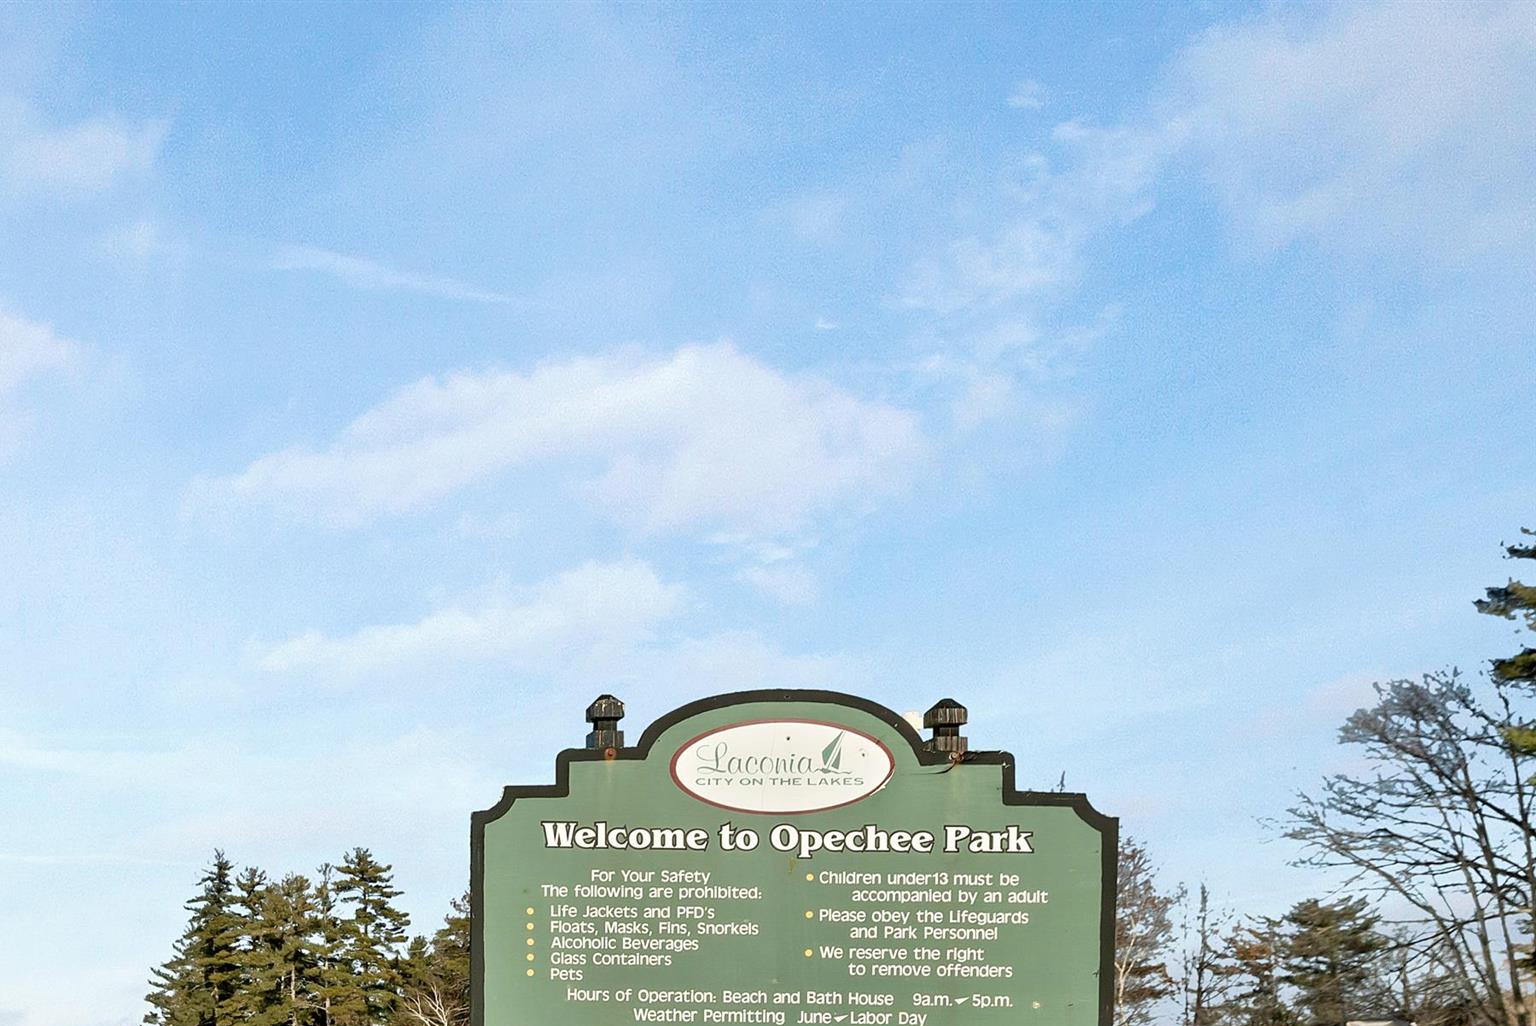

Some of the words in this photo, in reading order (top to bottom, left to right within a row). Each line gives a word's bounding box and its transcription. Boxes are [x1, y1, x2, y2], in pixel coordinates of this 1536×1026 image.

[696, 742, 816, 775] Laconia
[695, 777, 735, 787] CITY
[739, 778, 764, 787] ON
[769, 777, 803, 787] THE
[807, 777, 864, 787] LAKES
[542, 821, 708, 851] Welcome
[719, 822, 761, 850] to
[770, 824, 934, 858] Opechee
[942, 825, 1034, 854] Park
[590, 869, 615, 883] For
[621, 869, 655, 883] Your
[660, 870, 711, 885] Safety
[818, 870, 882, 886] Children
[953, 873, 994, 887] must
[998, 872, 1020, 887] be
[541, 884, 569, 898] The
[573, 884, 644, 900] following
[648, 887, 674, 900] are
[678, 886, 763, 901] prohibited:
[851, 888, 952, 905] accompanied
[957, 889, 978, 905] by
[982, 890, 1002, 904] an
[1007, 889, 1049, 905] adult
[549, 905, 578, 917] Life
[582, 905, 638, 918] Jackets
[642, 906, 671, 919] and
[675, 906, 716, 920] PFD's
[818, 908, 867, 923] Please
[871, 909, 911, 924] obey
[915, 909, 944, 923] the
[948, 909, 1029, 926] Lifeguards
[549, 920, 599, 936] Floats,
[604, 921, 653, 937] Masks,
[658, 921, 692, 937] Fins,
[696, 922, 760, 936] Snorkels
[849, 925, 878, 939] and
[883, 925, 918, 940] Park
[923, 926, 999, 940] Personnel
[550, 936, 617, 950] Alcoholic
[622, 937, 700, 952] Beverages
[550, 952, 587, 965] Glass
[592, 952, 672, 966] Containers
[819, 945, 844, 959] We
[848, 947, 908, 960] reserve
[912, 946, 941, 960] the
[945, 946, 985, 963] right
[550, 967, 584, 981] Pets
[847, 963, 866, 976] to
[871, 965, 932, 977] remove
[936, 963, 1014, 979] offenders
[566, 988, 610, 1002] Hours
[614, 988, 633, 1002] of
[637, 989, 717, 1004] Operation:
[722, 990, 768, 1004] Beach
[772, 991, 801, 1005] and
[806, 991, 843, 1006] Bath
[848, 992, 895, 1006] House
[633, 1008, 698, 1023] Weather
[703, 1009, 786, 1026] Permitting
[796, 1011, 832, 1024] June
[849, 1011, 893, 1025] Labor
